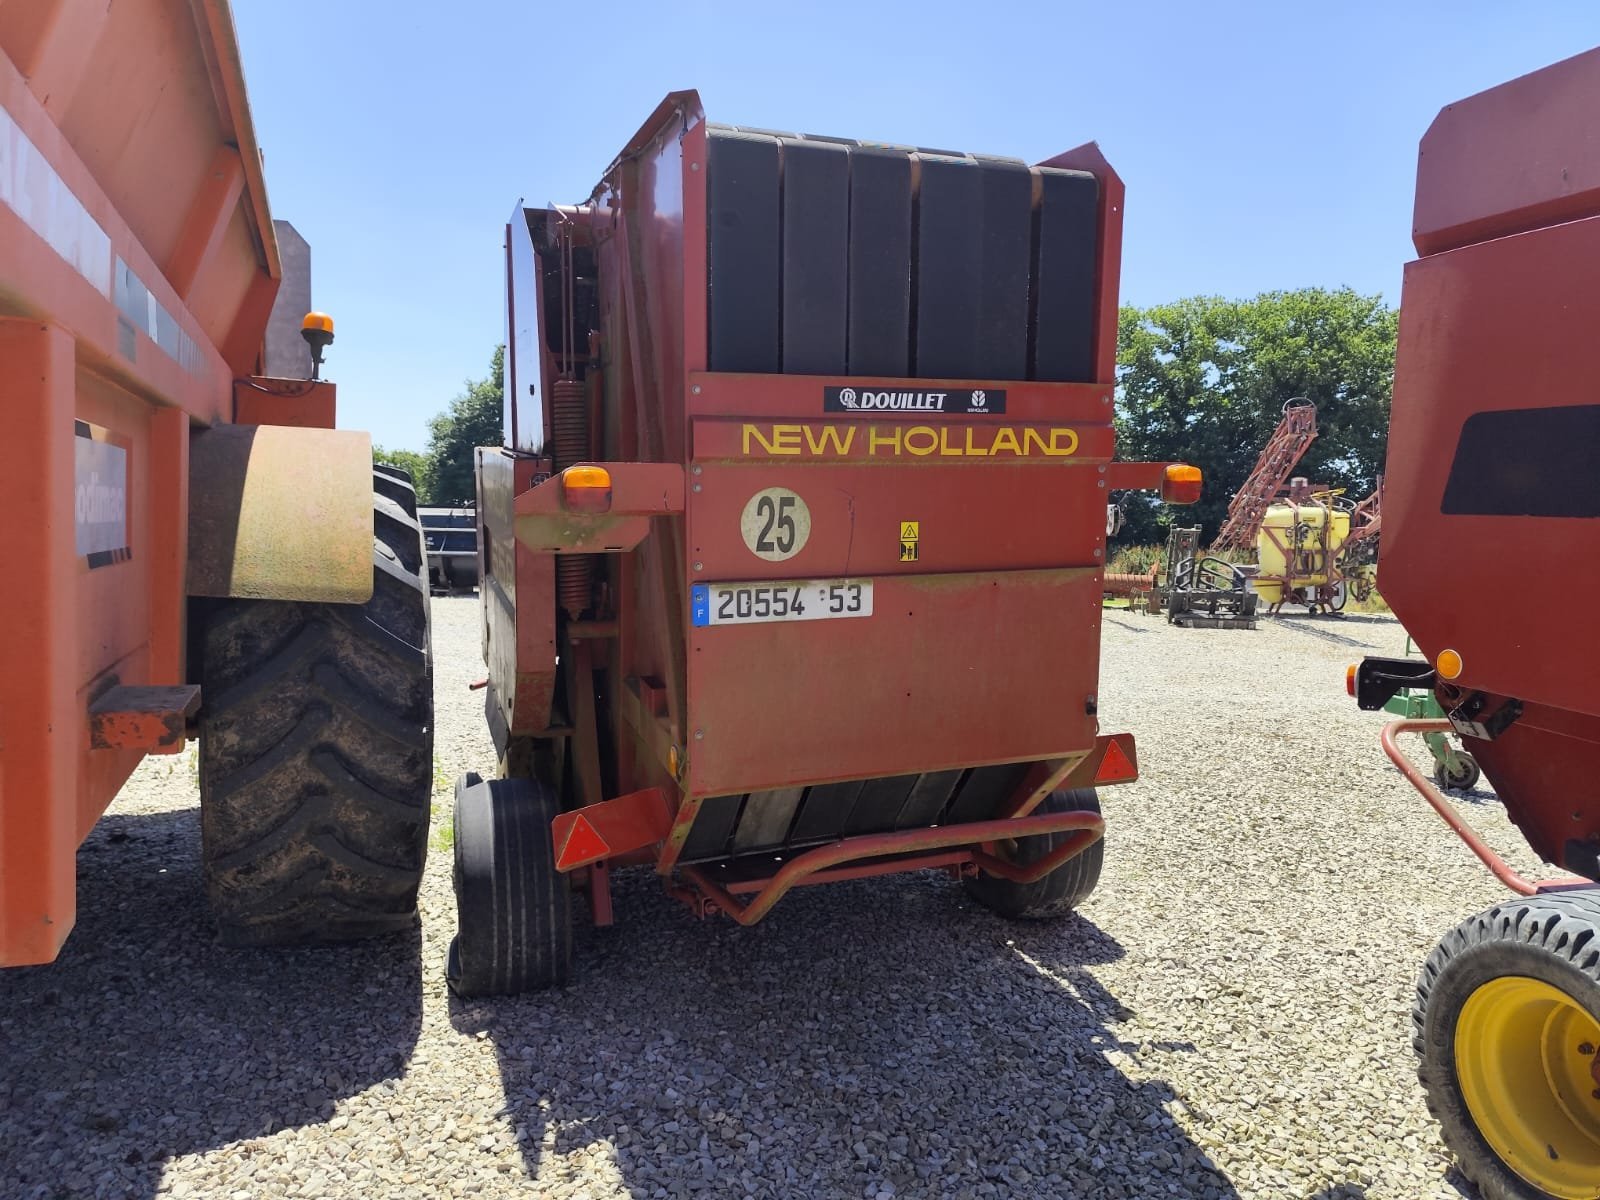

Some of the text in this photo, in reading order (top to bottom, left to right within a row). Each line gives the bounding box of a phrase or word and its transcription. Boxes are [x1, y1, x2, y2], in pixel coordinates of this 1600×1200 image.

[861, 392, 947, 410] DOUILLET
[743, 424, 1079, 456] NEW HOLLAND
[756, 496, 796, 553] 25
[697, 609, 704, 621] F
[718, 584, 861, 619] 20554 53
